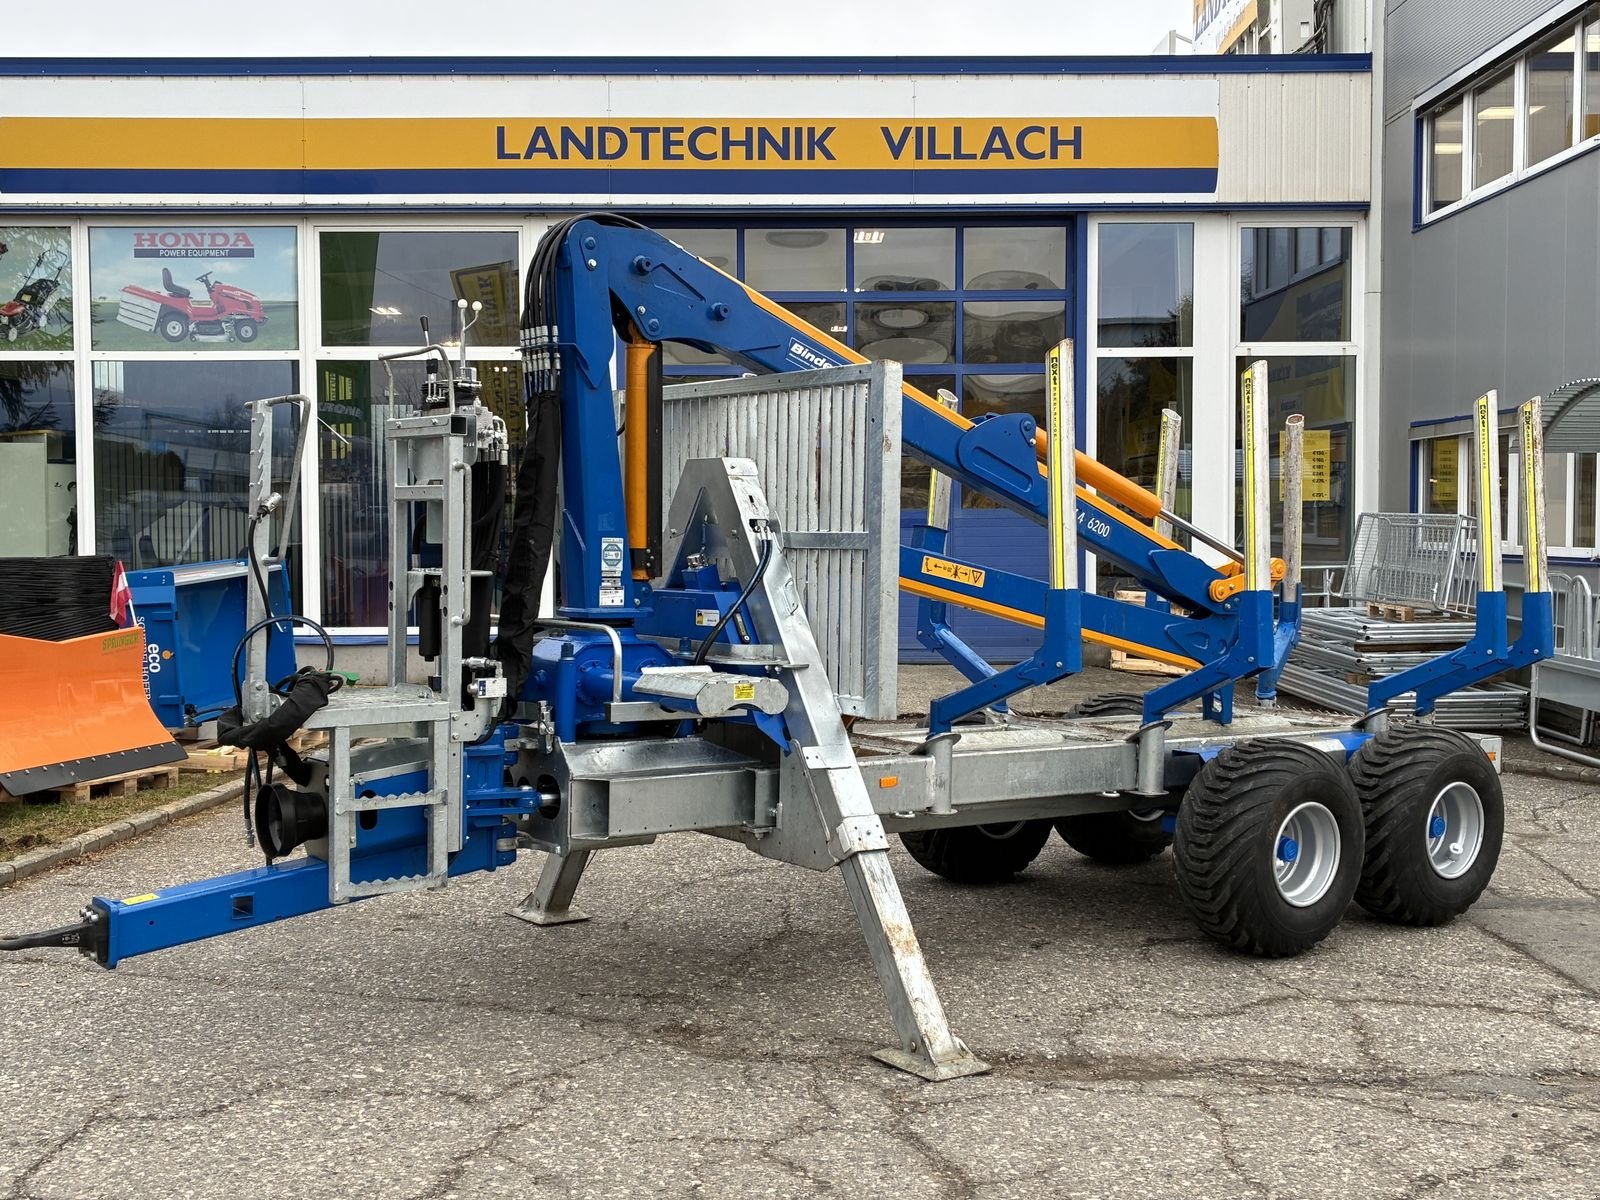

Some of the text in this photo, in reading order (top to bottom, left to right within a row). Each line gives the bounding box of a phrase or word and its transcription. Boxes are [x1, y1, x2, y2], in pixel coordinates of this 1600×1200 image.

[496, 126, 1082, 160] LANDTECHNIK VILLACH
[133, 231, 254, 248] HONDA
[159, 249, 230, 257] POWER EQUIPMENT
[1050, 356, 1058, 385] next
[1244, 377, 1252, 404] next
[1087, 517, 1110, 537] 6200
[147, 643, 161, 673] eco
